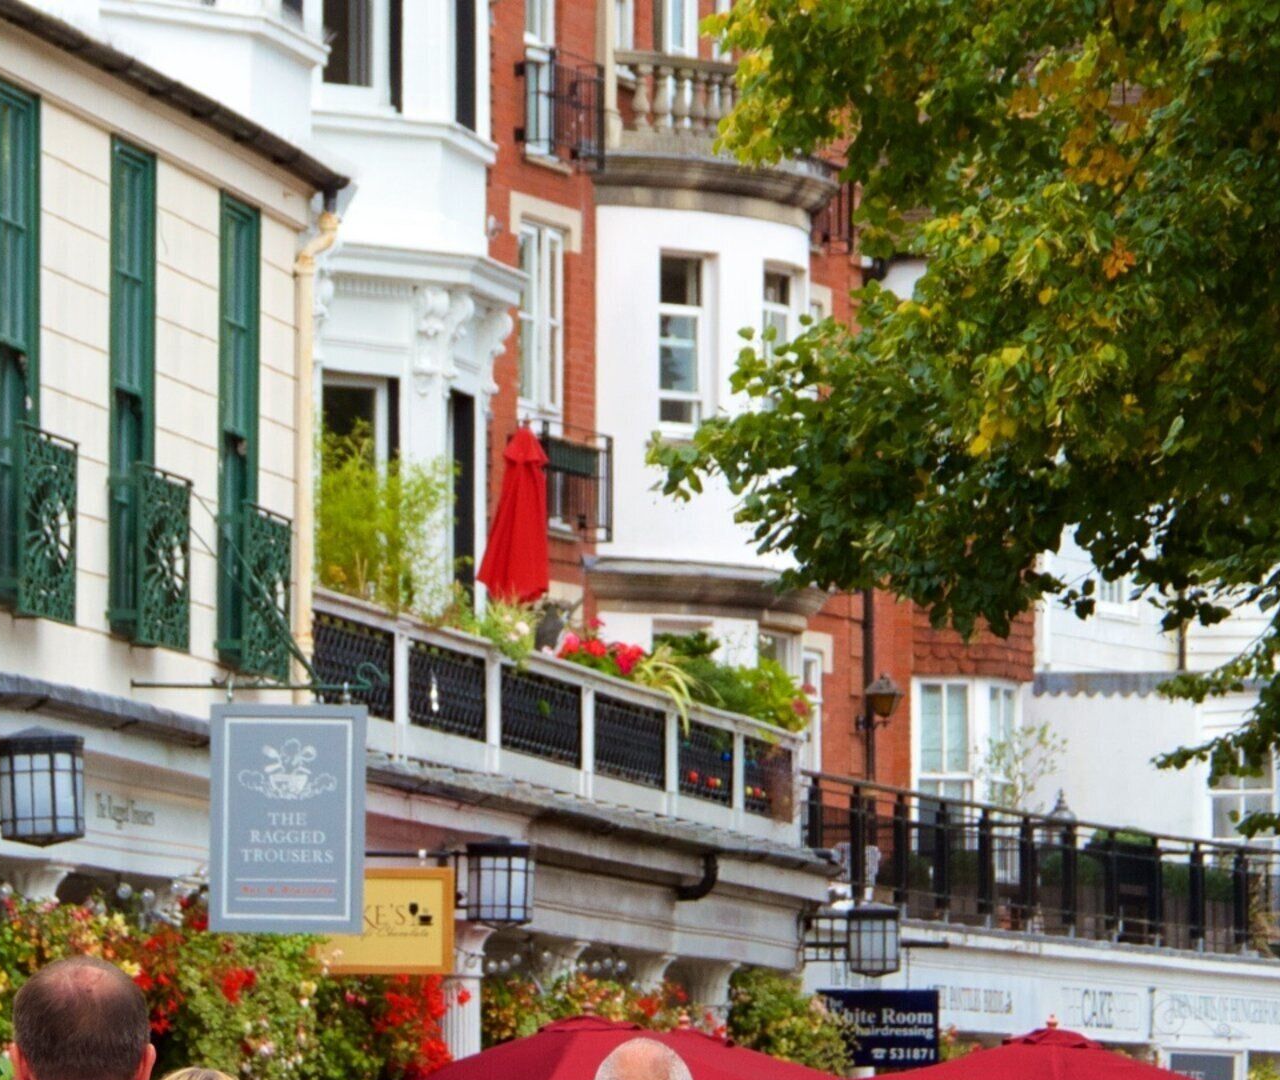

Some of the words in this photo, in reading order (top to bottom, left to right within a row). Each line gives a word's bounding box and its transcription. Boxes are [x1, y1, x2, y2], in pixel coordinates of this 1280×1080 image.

[266, 811, 308, 827] THE
[248, 829, 326, 845] RAGGED
[239, 848, 335, 864] TROUSERS
[880, 1008, 934, 1025] Room
[1081, 988, 1114, 1029] CAKE
[854, 1025, 934, 1040] hairdressing
[888, 1047, 935, 1061] 531871
